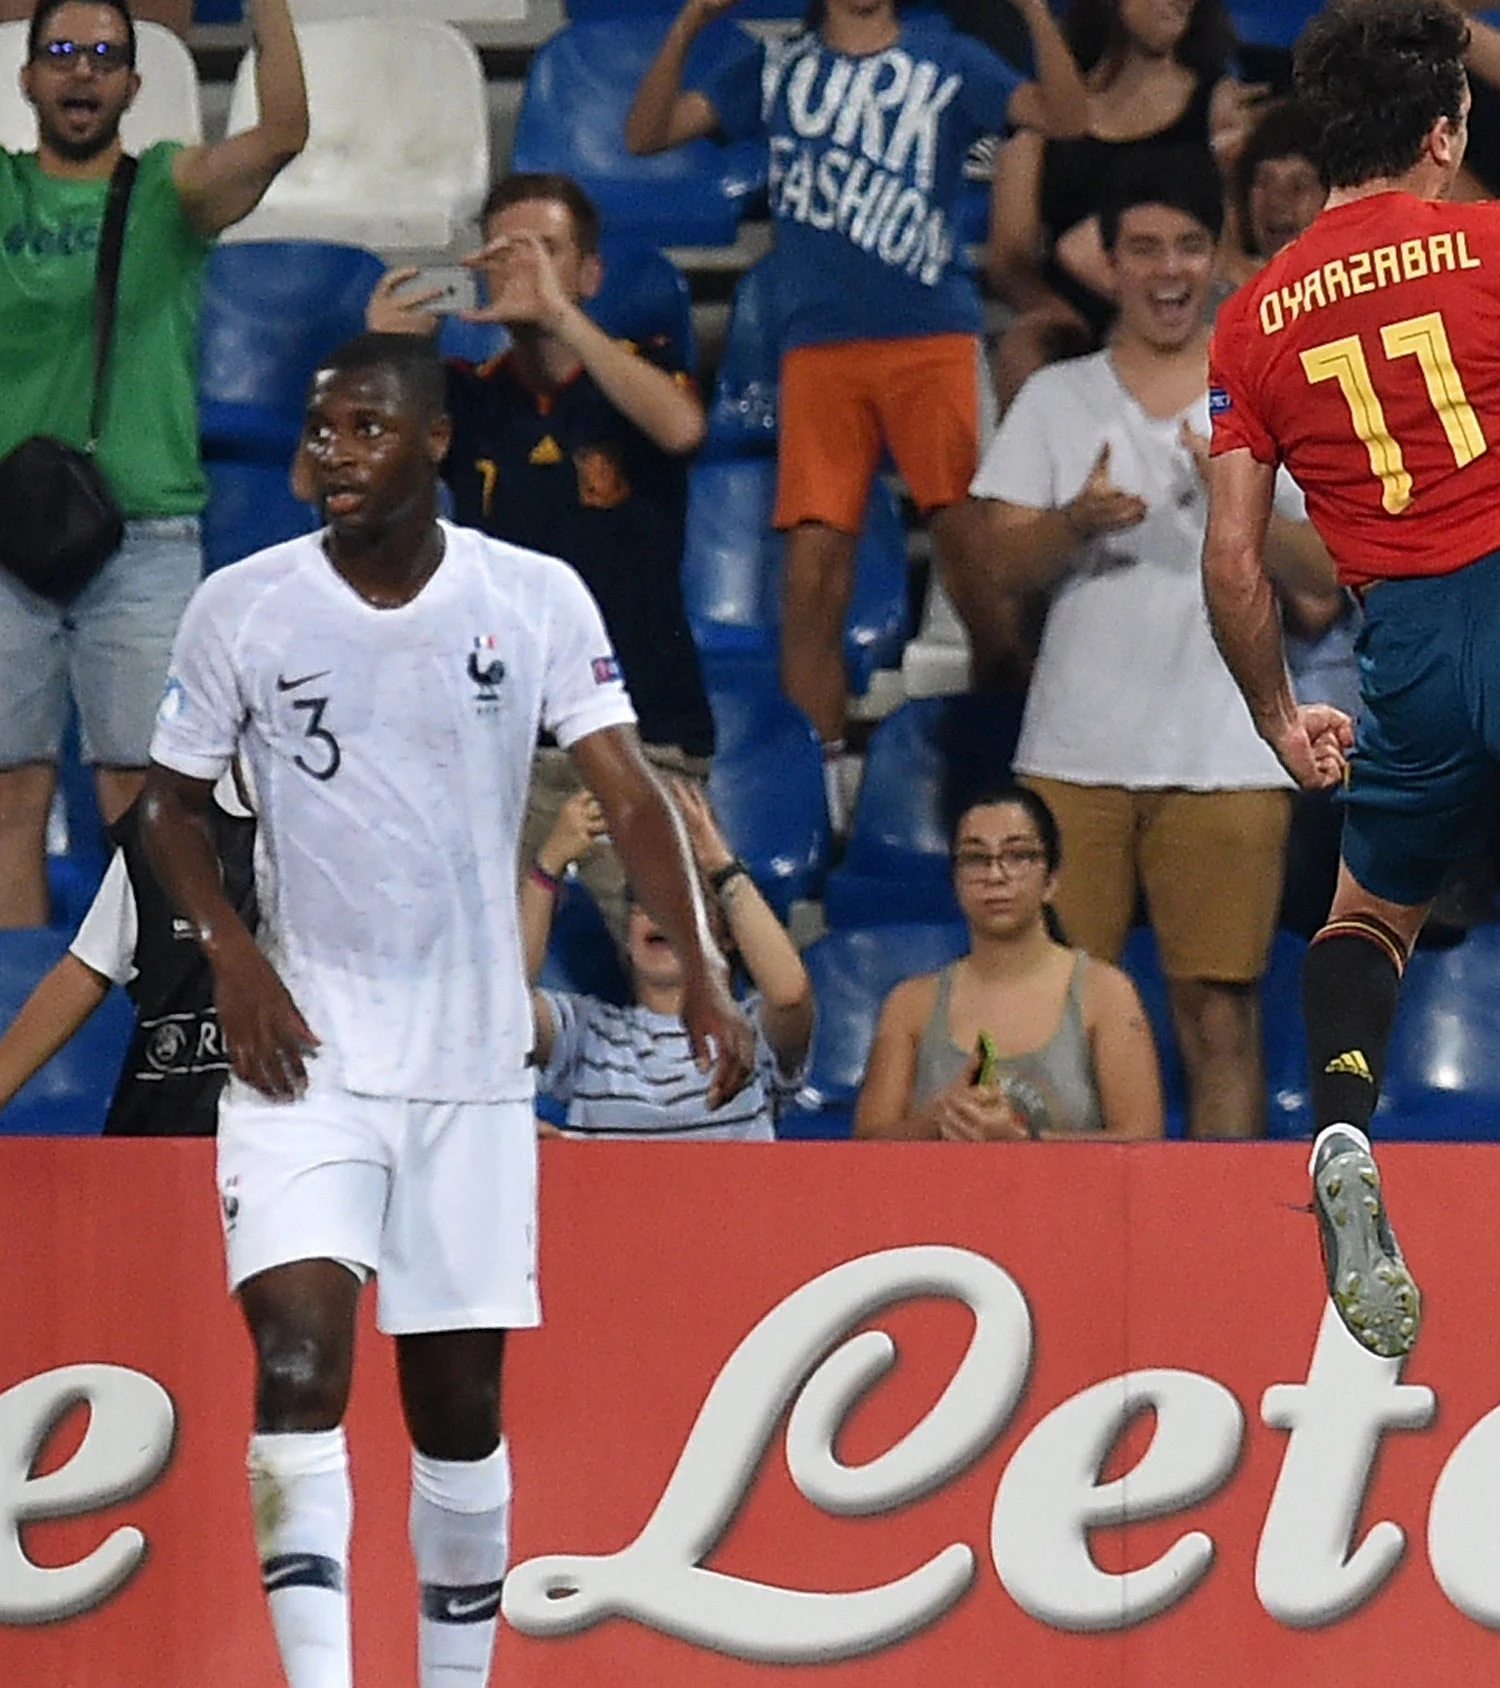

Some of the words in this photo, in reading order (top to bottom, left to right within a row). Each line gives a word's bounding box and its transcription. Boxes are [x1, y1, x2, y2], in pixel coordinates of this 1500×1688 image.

[768, 135, 951, 287] FASHION
[1259, 231, 1482, 336] OYARZABAL
[1299, 311, 1488, 515] 11
[292, 697, 340, 781] 3
